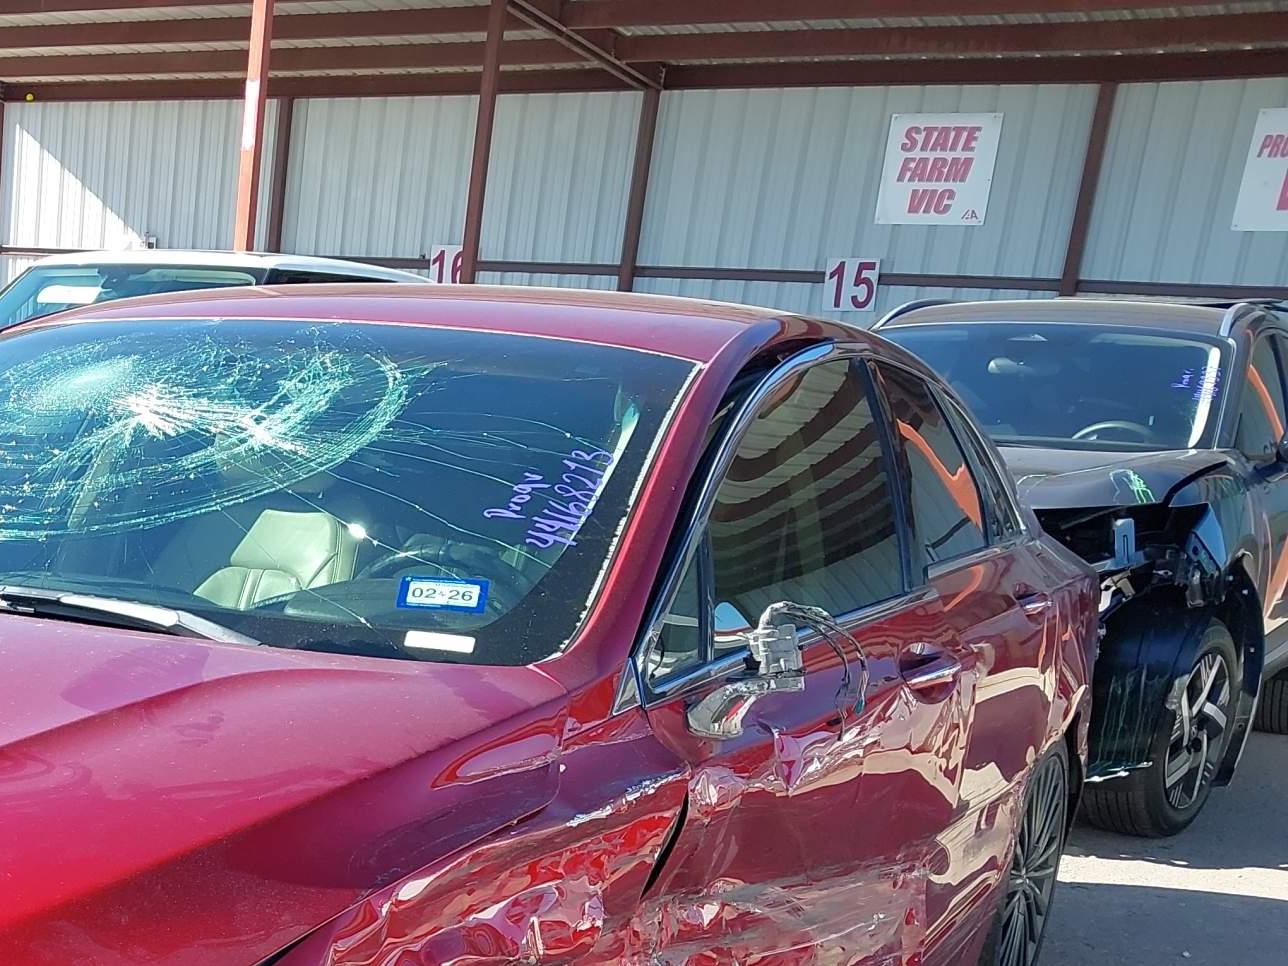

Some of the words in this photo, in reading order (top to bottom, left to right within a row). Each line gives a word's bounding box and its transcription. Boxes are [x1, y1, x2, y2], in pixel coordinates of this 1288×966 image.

[900, 125, 983, 153] STATE
[896, 157, 975, 183] FARM
[907, 188, 957, 215] VIC
[828, 261, 876, 310] 15
